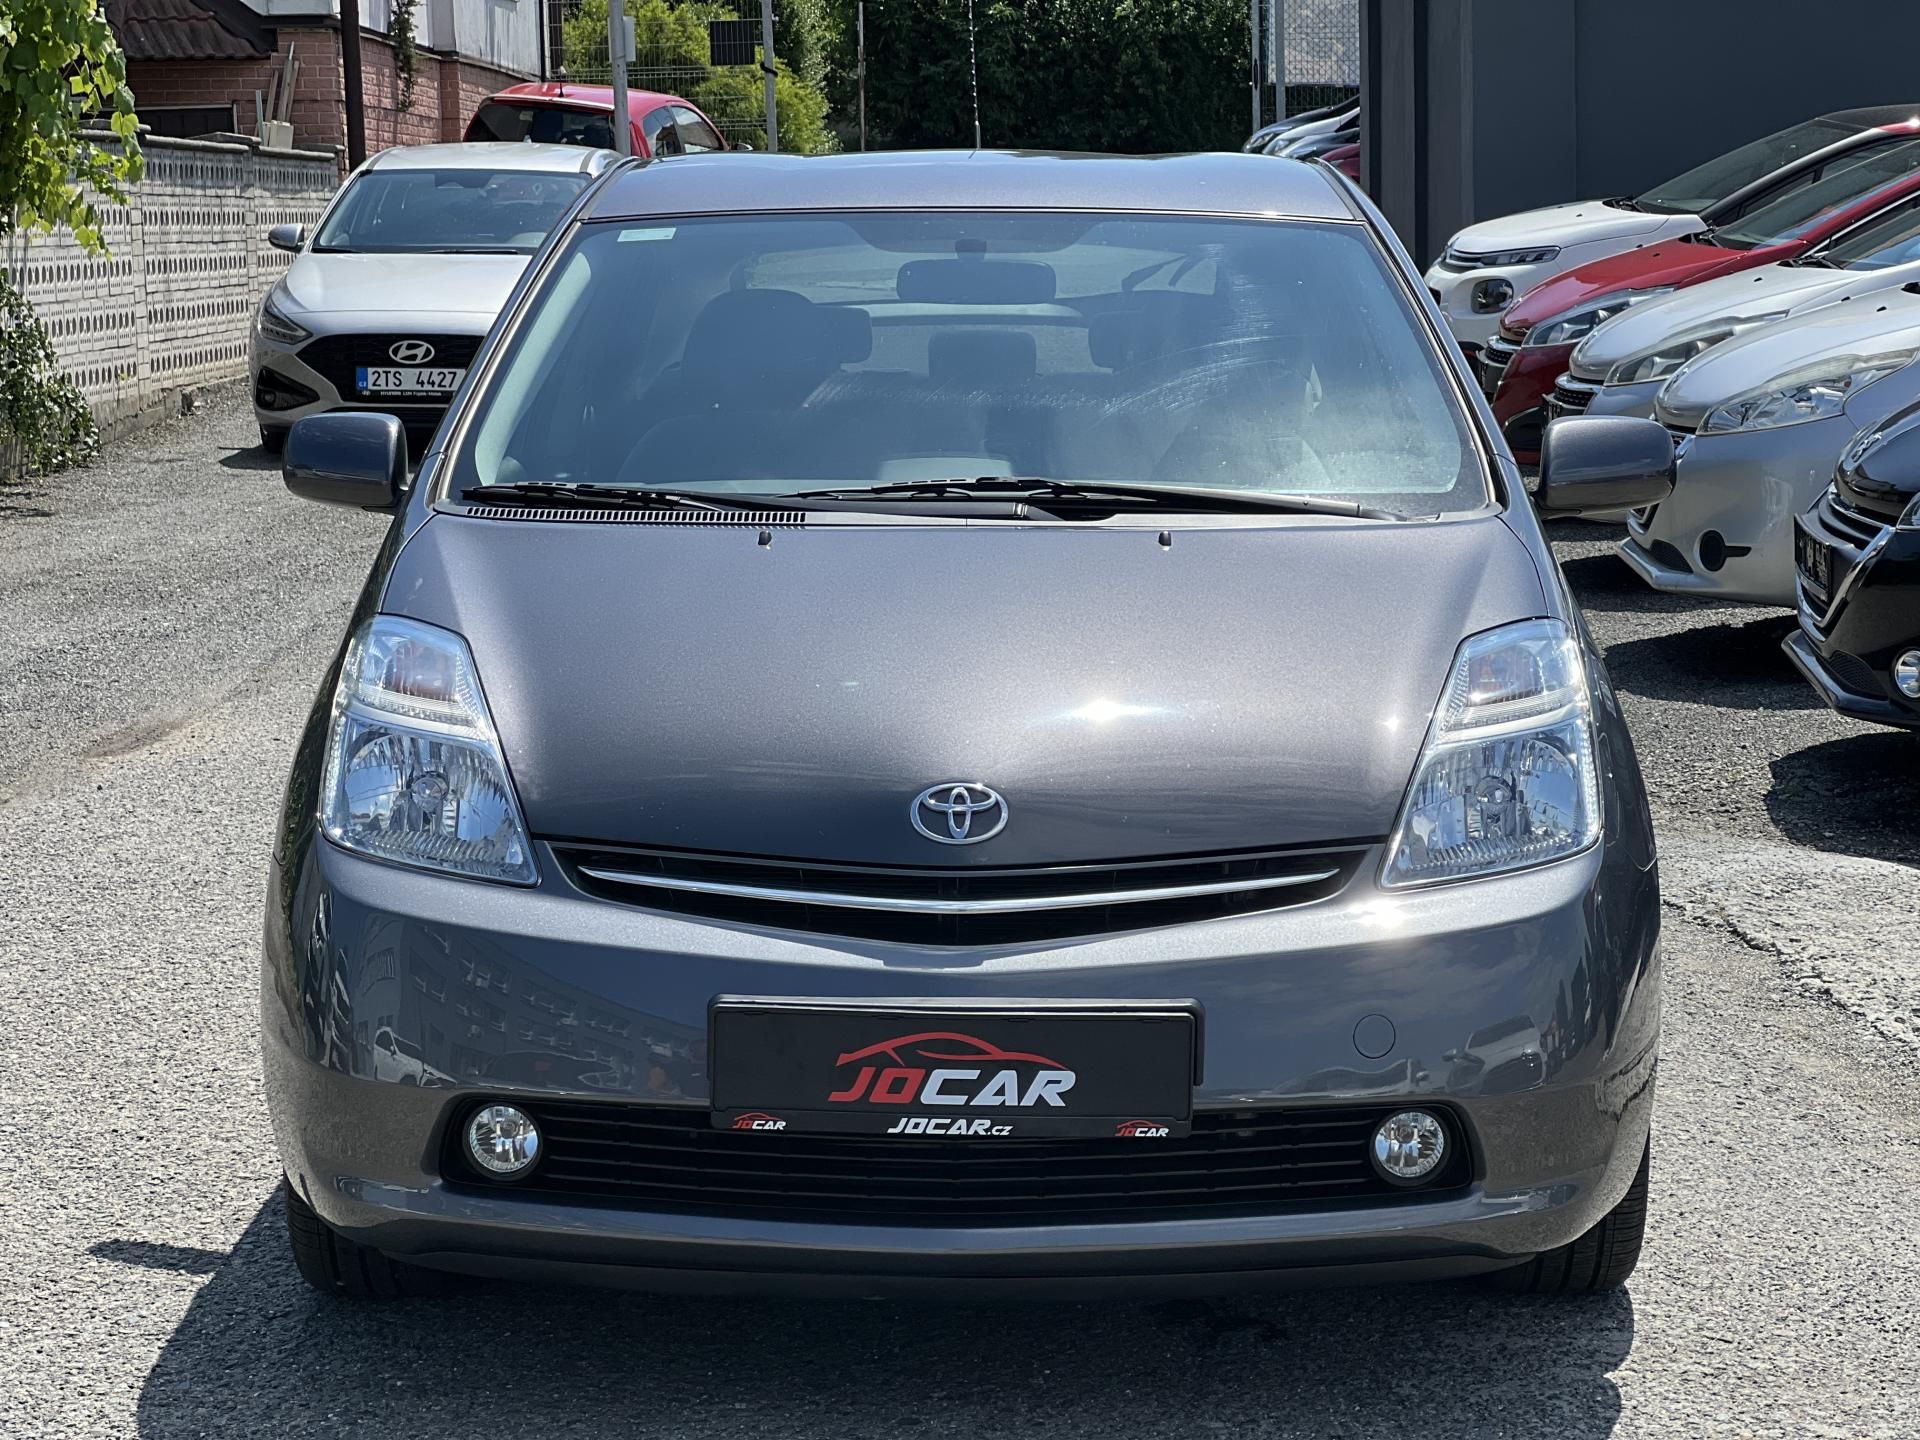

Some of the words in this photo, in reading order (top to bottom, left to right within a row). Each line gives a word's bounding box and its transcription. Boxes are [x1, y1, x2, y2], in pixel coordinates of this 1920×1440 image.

[371, 370, 402, 387] 2TS
[416, 371, 457, 388] 4427
[828, 1067, 1076, 1107] JOCAR
[732, 1120, 787, 1130] JOCAR
[1115, 1127, 1169, 1137] JOCAR
